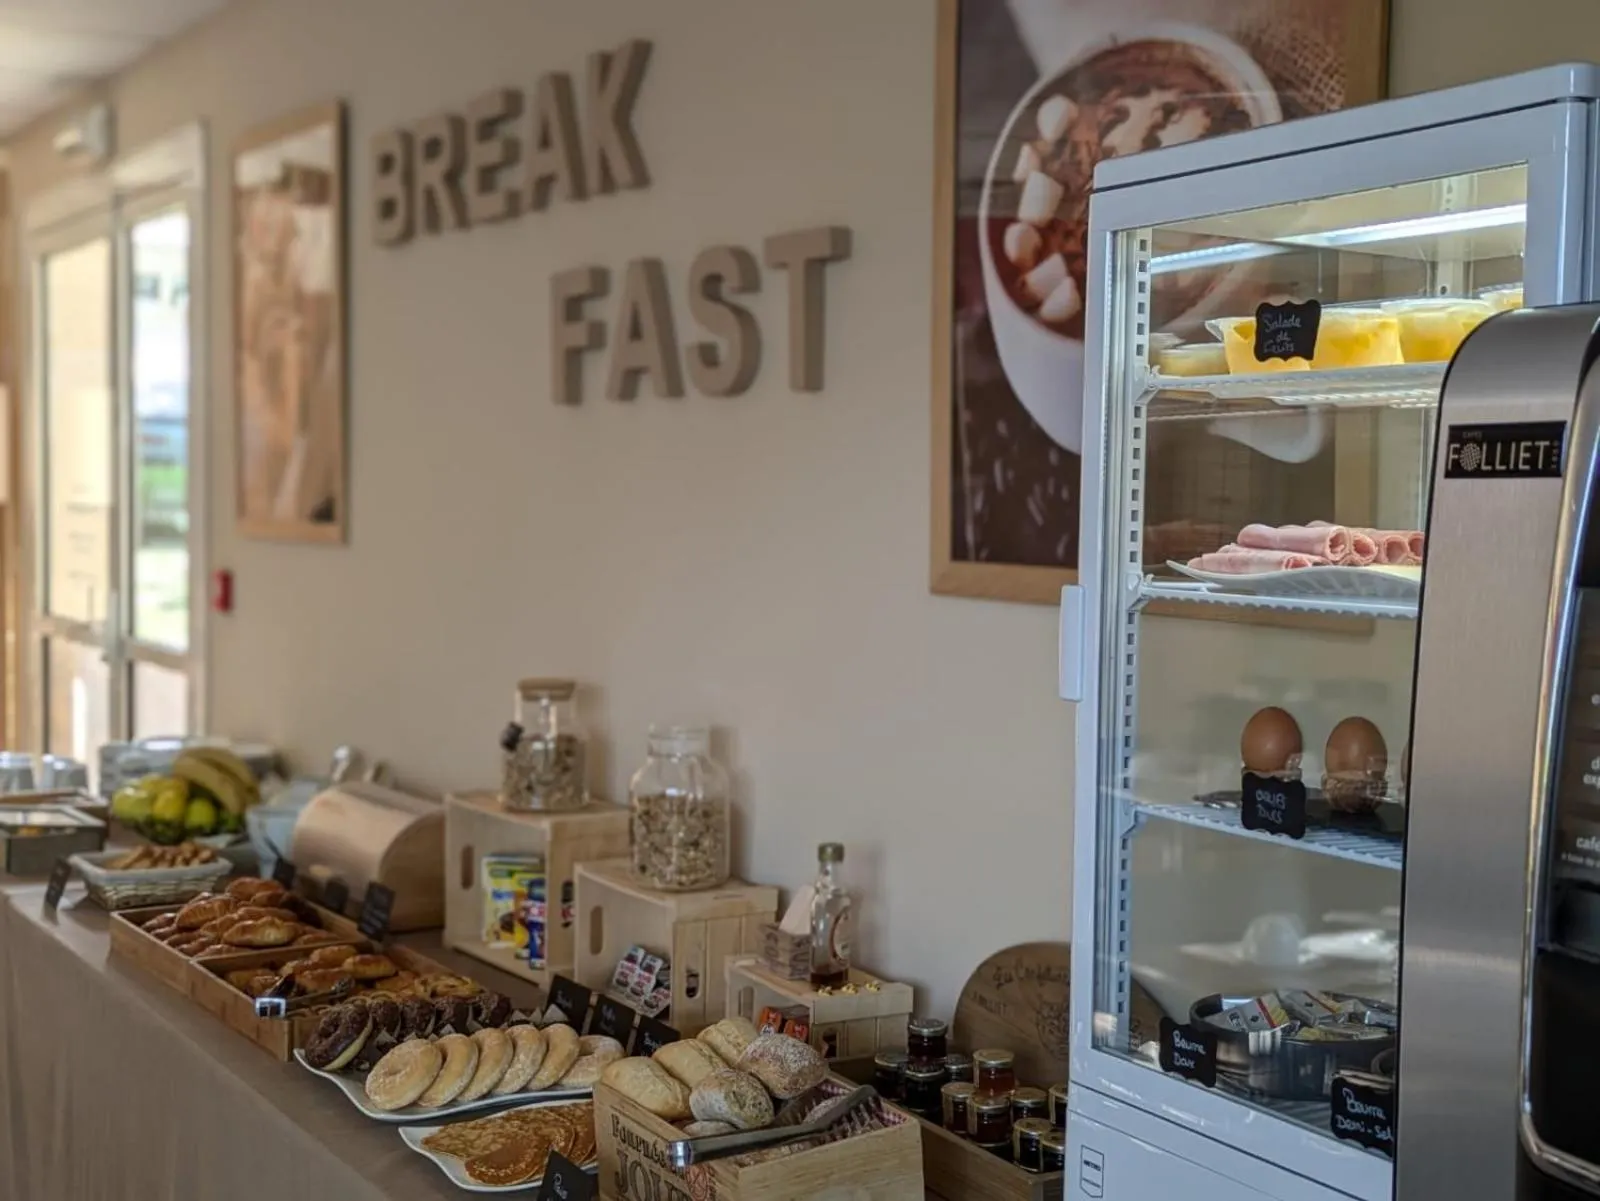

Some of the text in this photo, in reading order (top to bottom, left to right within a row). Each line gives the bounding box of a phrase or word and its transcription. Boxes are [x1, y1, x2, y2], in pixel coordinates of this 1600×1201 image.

[370, 38, 654, 249] BREAK
[549, 225, 854, 406] FAST
[1447, 439, 1550, 472] FOLLIET
